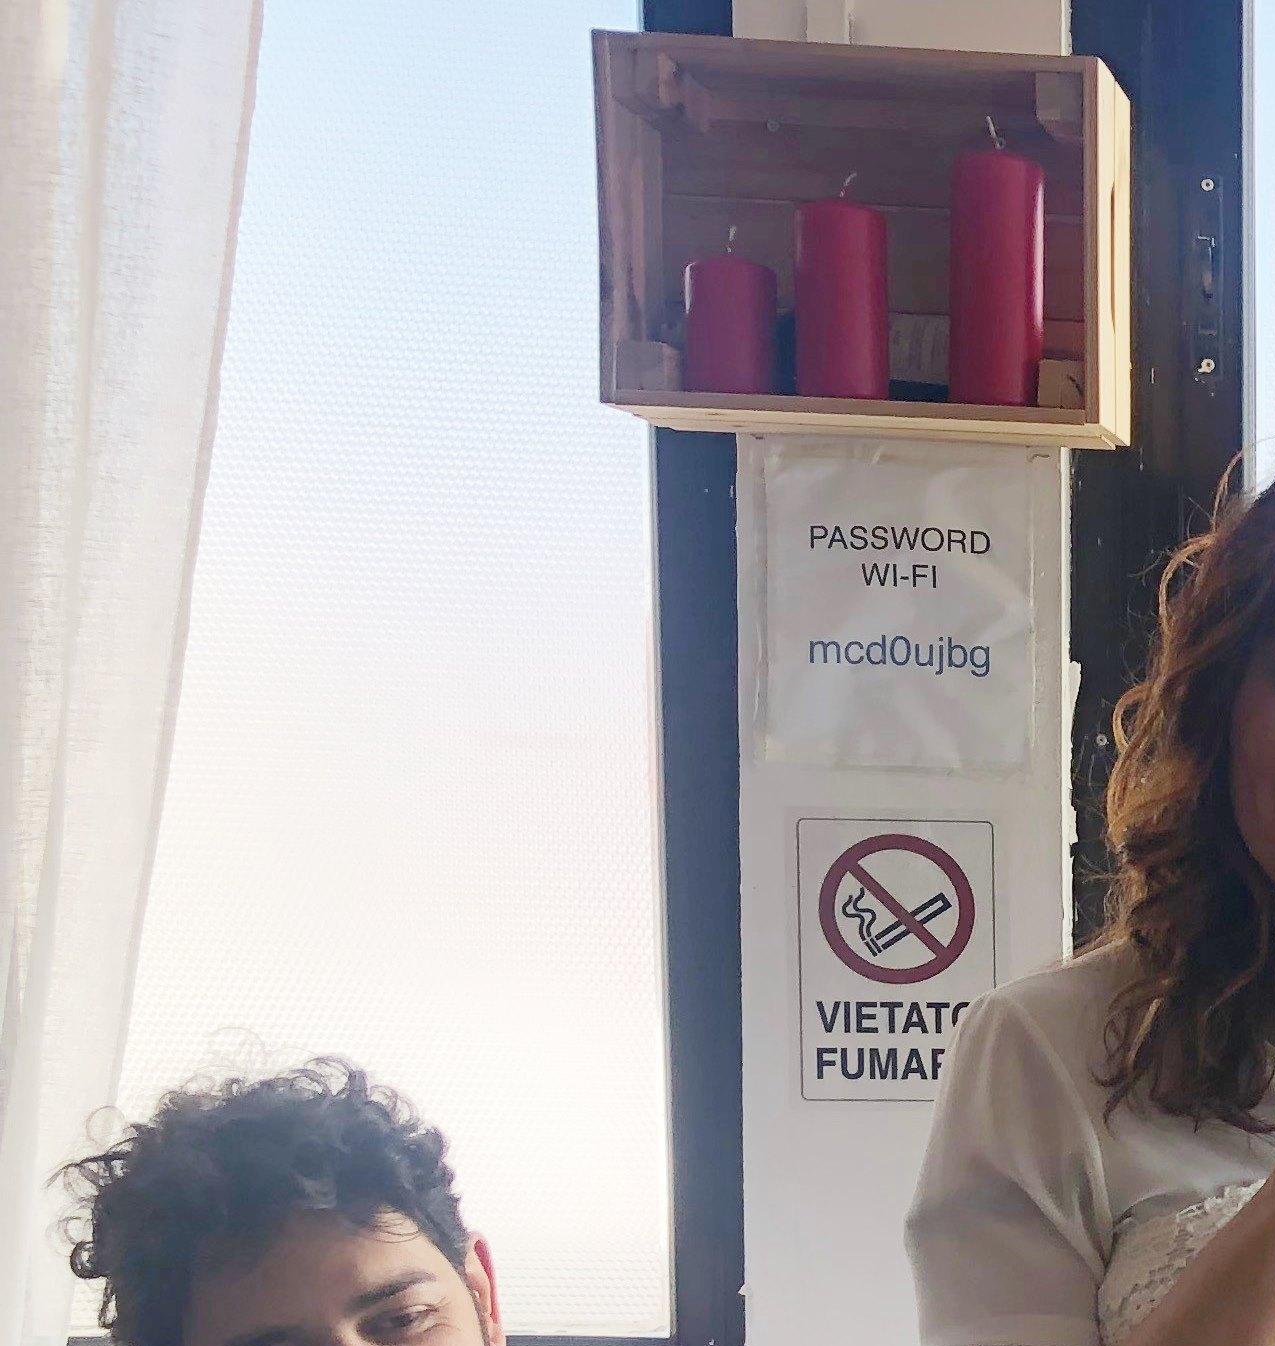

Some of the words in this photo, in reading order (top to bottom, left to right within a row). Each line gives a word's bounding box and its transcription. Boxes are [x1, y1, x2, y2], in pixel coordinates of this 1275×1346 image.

[809, 524, 991, 554] PASSWORD
[861, 561, 937, 588] WI-FI
[809, 634, 991, 677] mcd0ujbg
